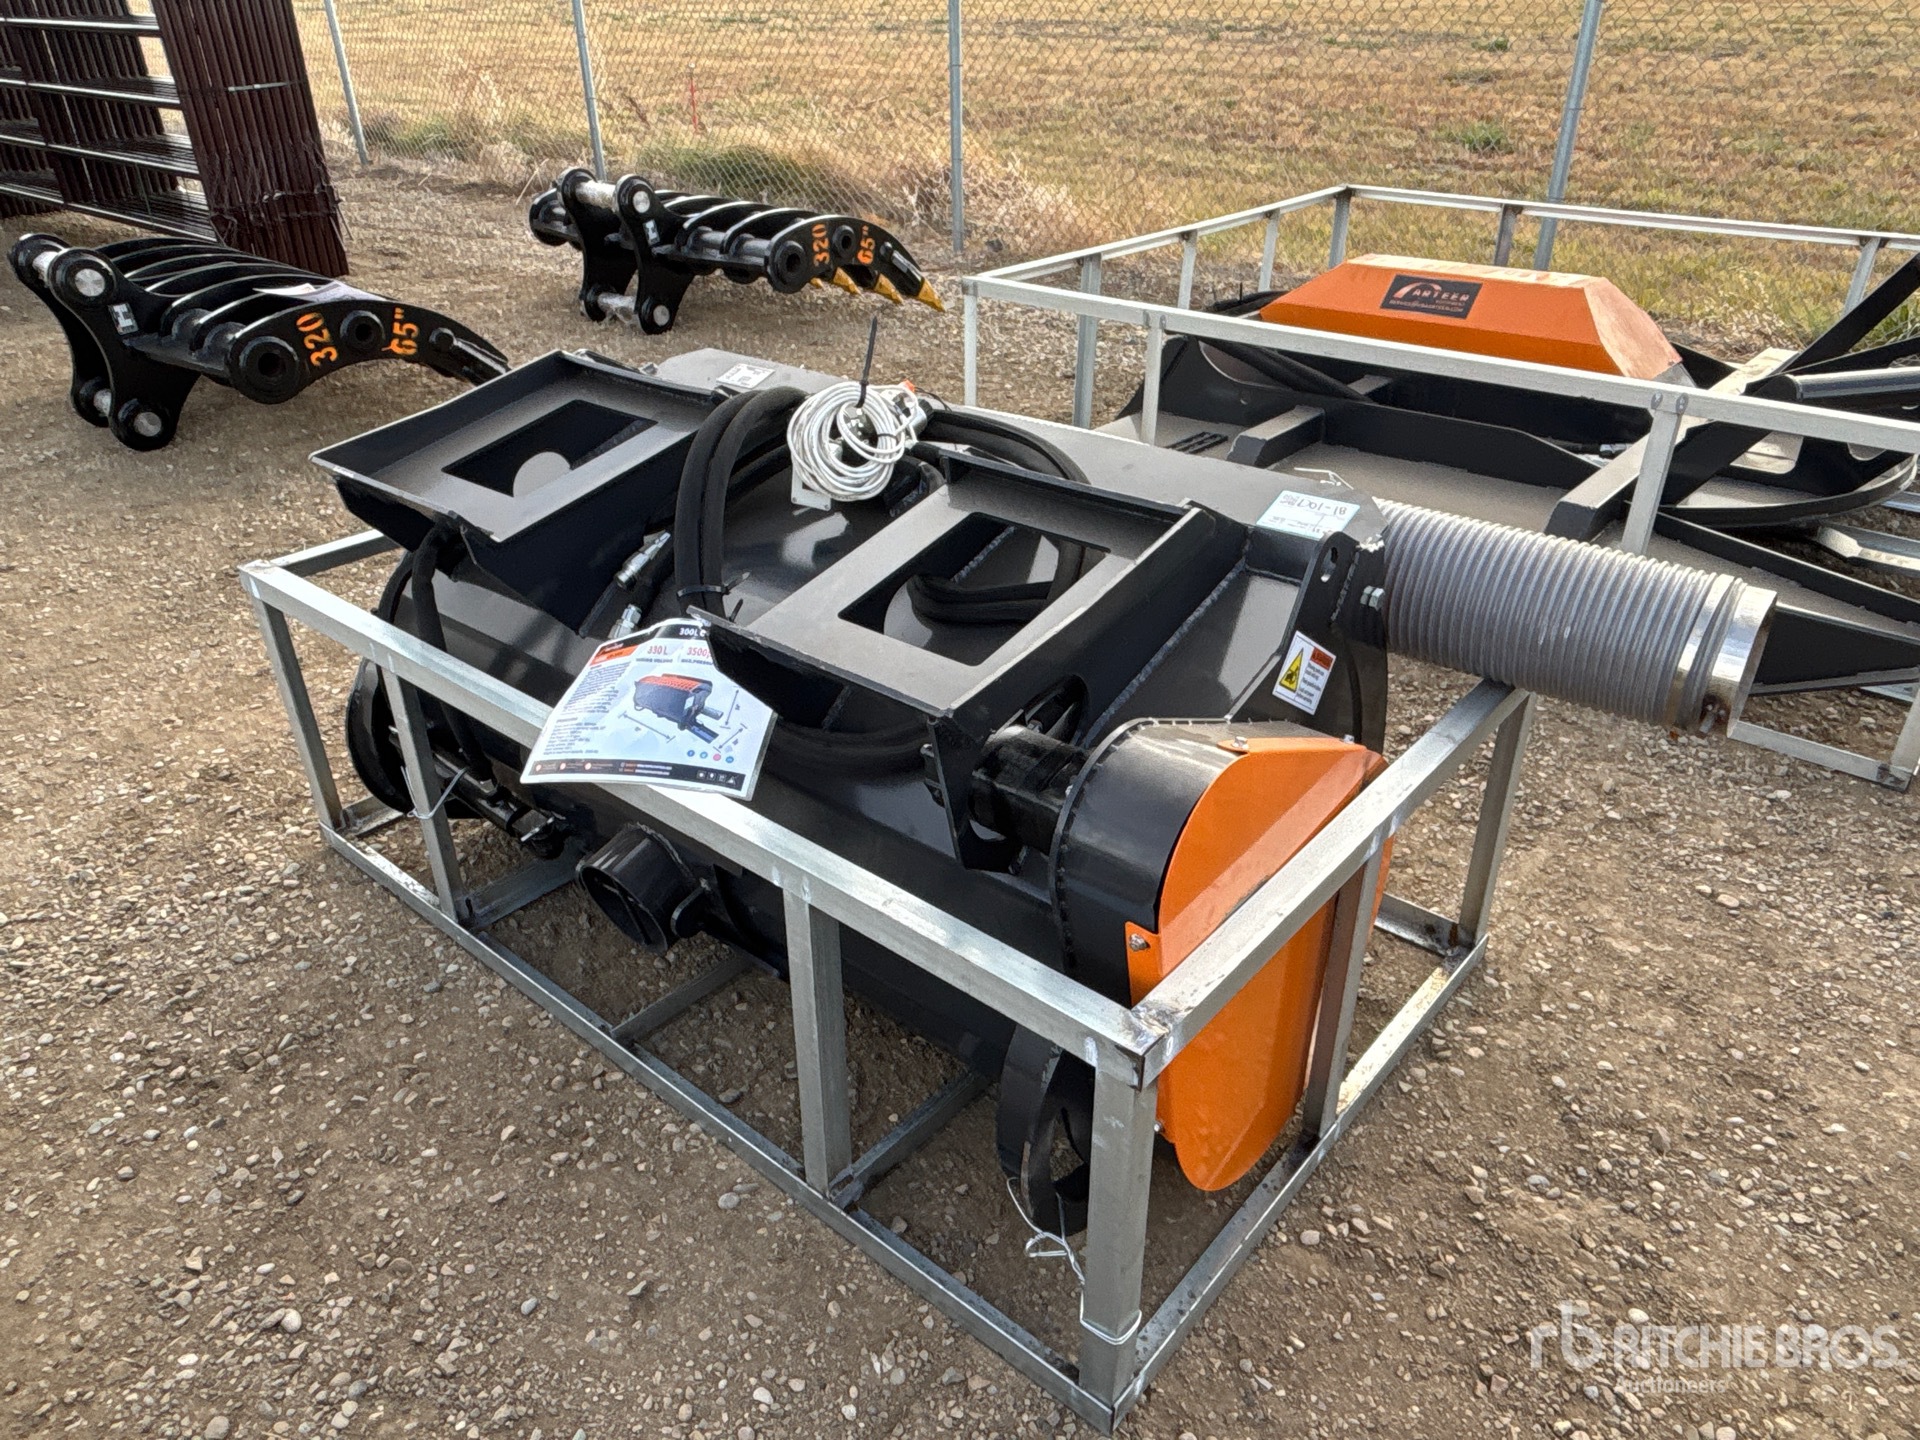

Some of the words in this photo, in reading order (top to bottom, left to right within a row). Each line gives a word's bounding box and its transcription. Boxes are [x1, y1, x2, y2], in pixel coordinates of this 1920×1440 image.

[812, 223, 830, 267] 320
[296, 311, 338, 367] 320
[679, 627, 699, 637] 300L
